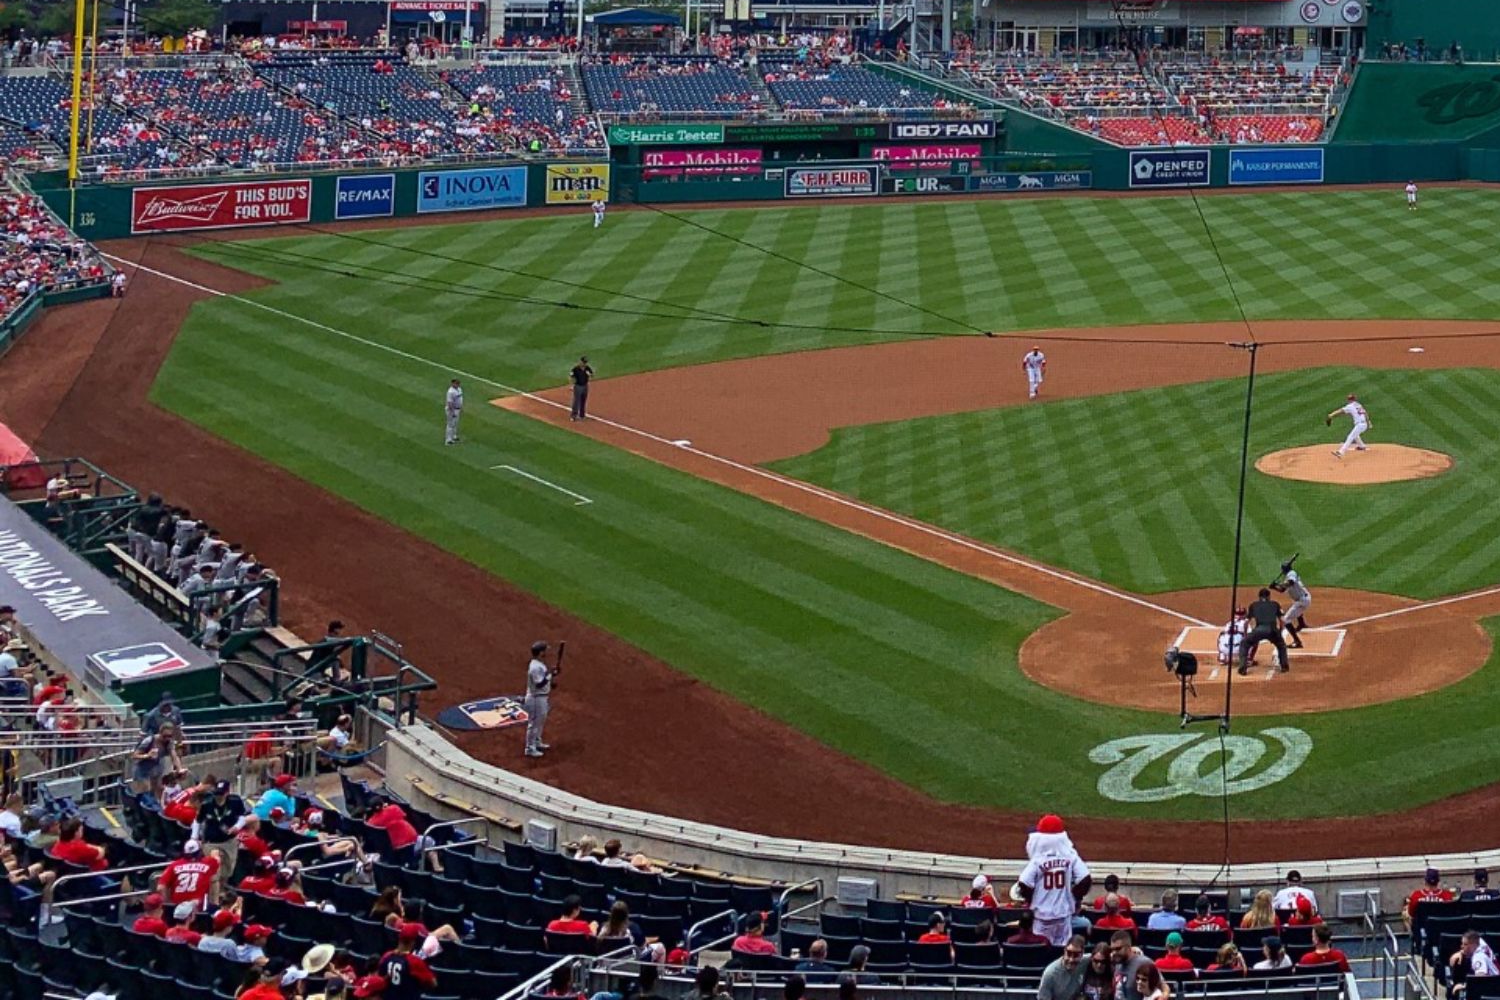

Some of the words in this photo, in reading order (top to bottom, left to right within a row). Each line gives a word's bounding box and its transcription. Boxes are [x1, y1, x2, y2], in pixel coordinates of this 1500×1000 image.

[395, 2, 428, 10] ADVANCE
[630, 130, 674, 142] Harris
[678, 129, 720, 141] Teeter
[946, 124, 988, 136] FAN
[1156, 161, 1204, 171] PENFED
[446, 175, 511, 195] INOVA
[980, 177, 1007, 185] MGM
[1054, 174, 1080, 183] MGM
[235, 189, 264, 203] THIS
[268, 186, 307, 201] BUD'S
[339, 189, 391, 202] RE/MAX
[145, 201, 218, 216] Budweiser
[234, 204, 261, 220] FOR
[263, 203, 293, 218] YOU.
[33, 586, 109, 621] PARK
[1088, 727, 1313, 802] W
[175, 873, 199, 892] 31
[1044, 870, 1065, 890] 00
[387, 962, 402, 985] 16
